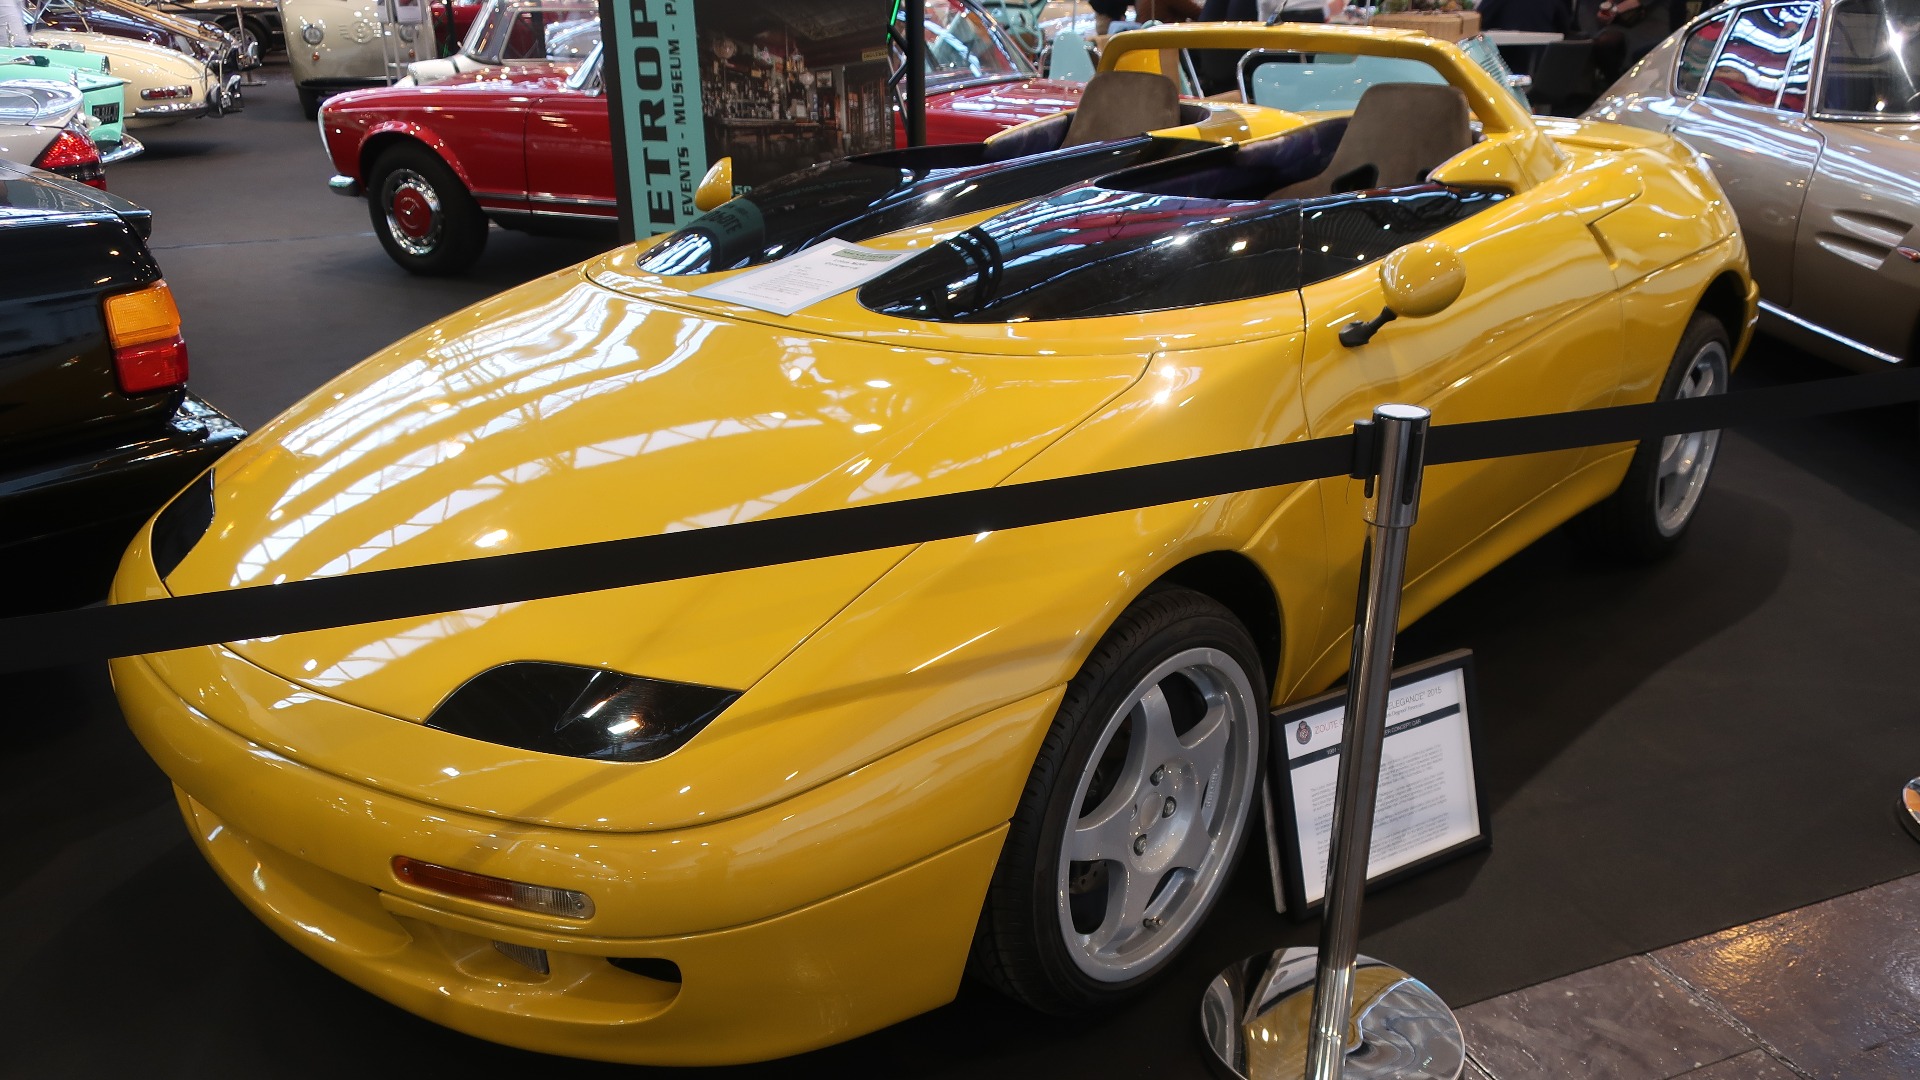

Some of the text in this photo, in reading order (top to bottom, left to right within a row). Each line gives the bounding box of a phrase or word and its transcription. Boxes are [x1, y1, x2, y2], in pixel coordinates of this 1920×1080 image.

[667, 38, 687, 125] MUSEUM
[629, 0, 675, 236] ETROP
[677, 146, 694, 216] EVENTS
[1315, 719, 1340, 735] ZOUTE
[1427, 686, 1442, 698] 2015
